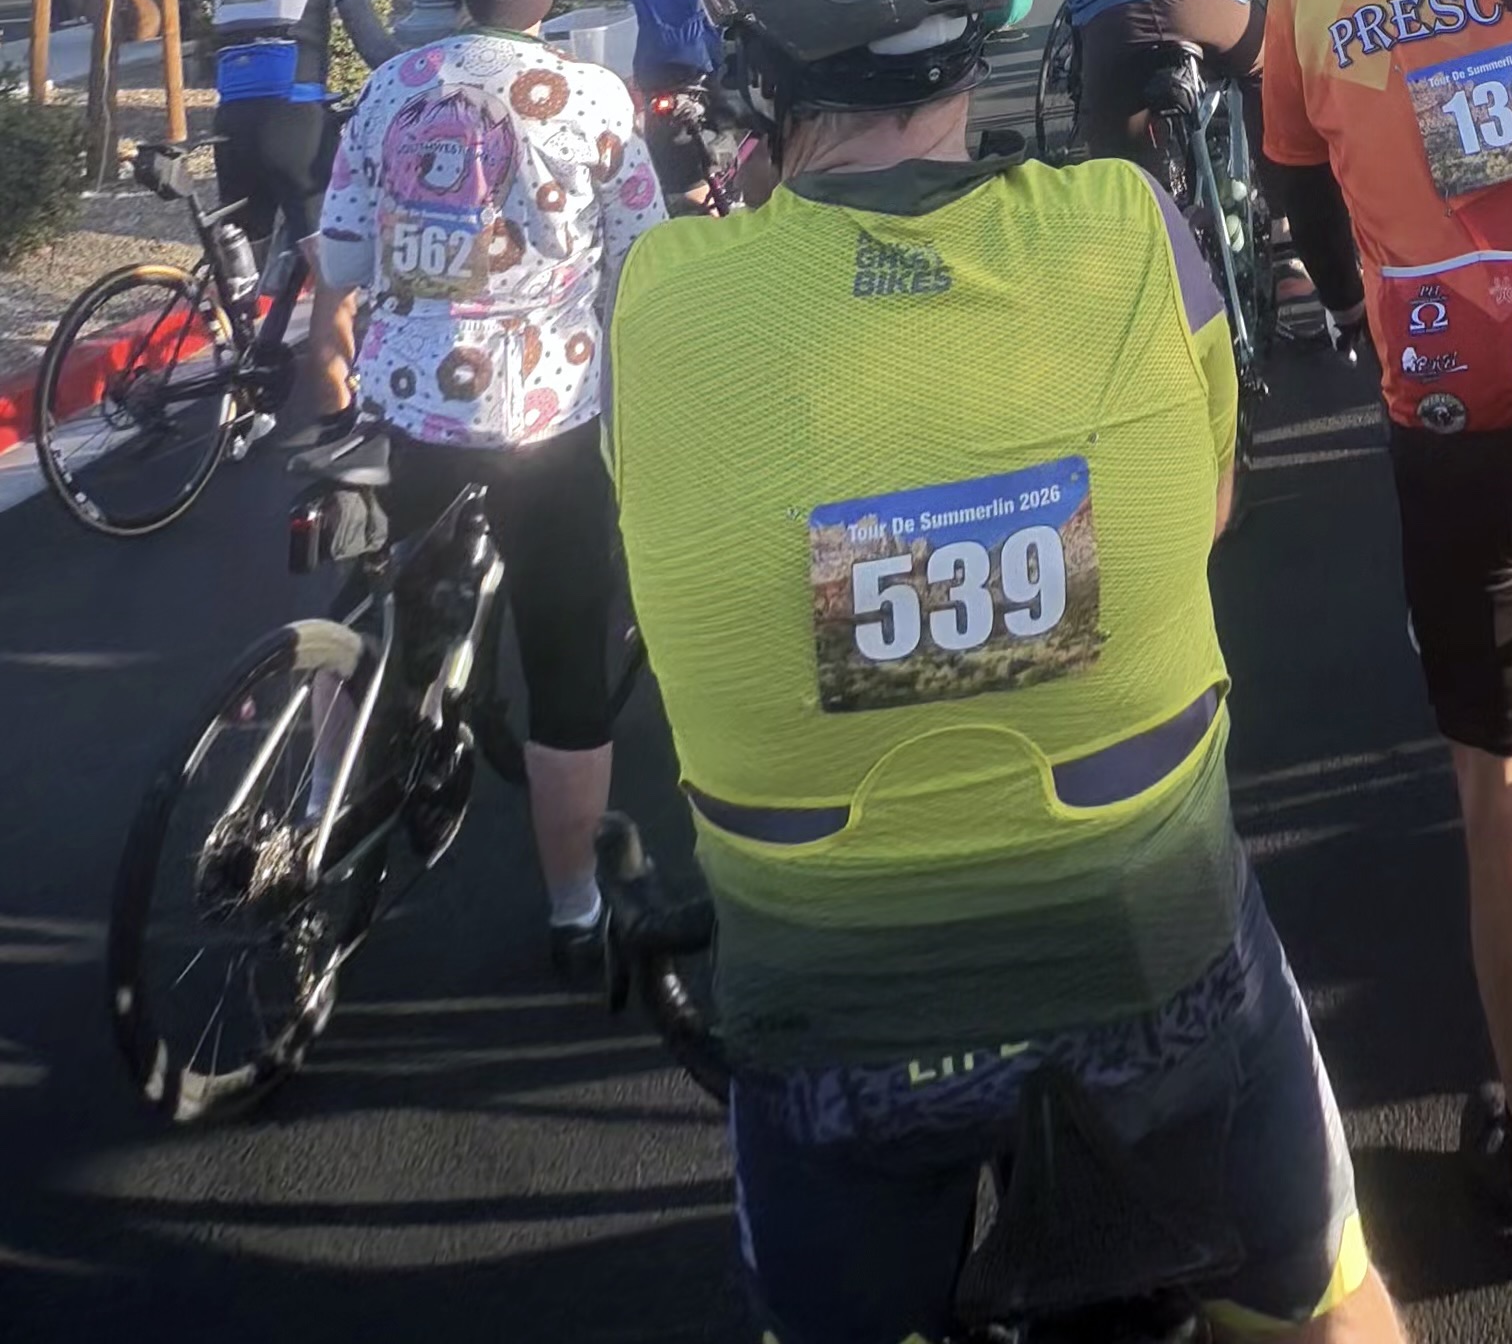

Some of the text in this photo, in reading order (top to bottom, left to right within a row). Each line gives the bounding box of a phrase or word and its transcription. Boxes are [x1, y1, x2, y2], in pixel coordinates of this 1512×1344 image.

[1428, 74, 1450, 88] Tour
[1452, 70, 1466, 81] De
[392, 223, 473, 278] 562
[848, 485, 1062, 543] Tour De Summerlin 2026
[852, 524, 1068, 661] 539
